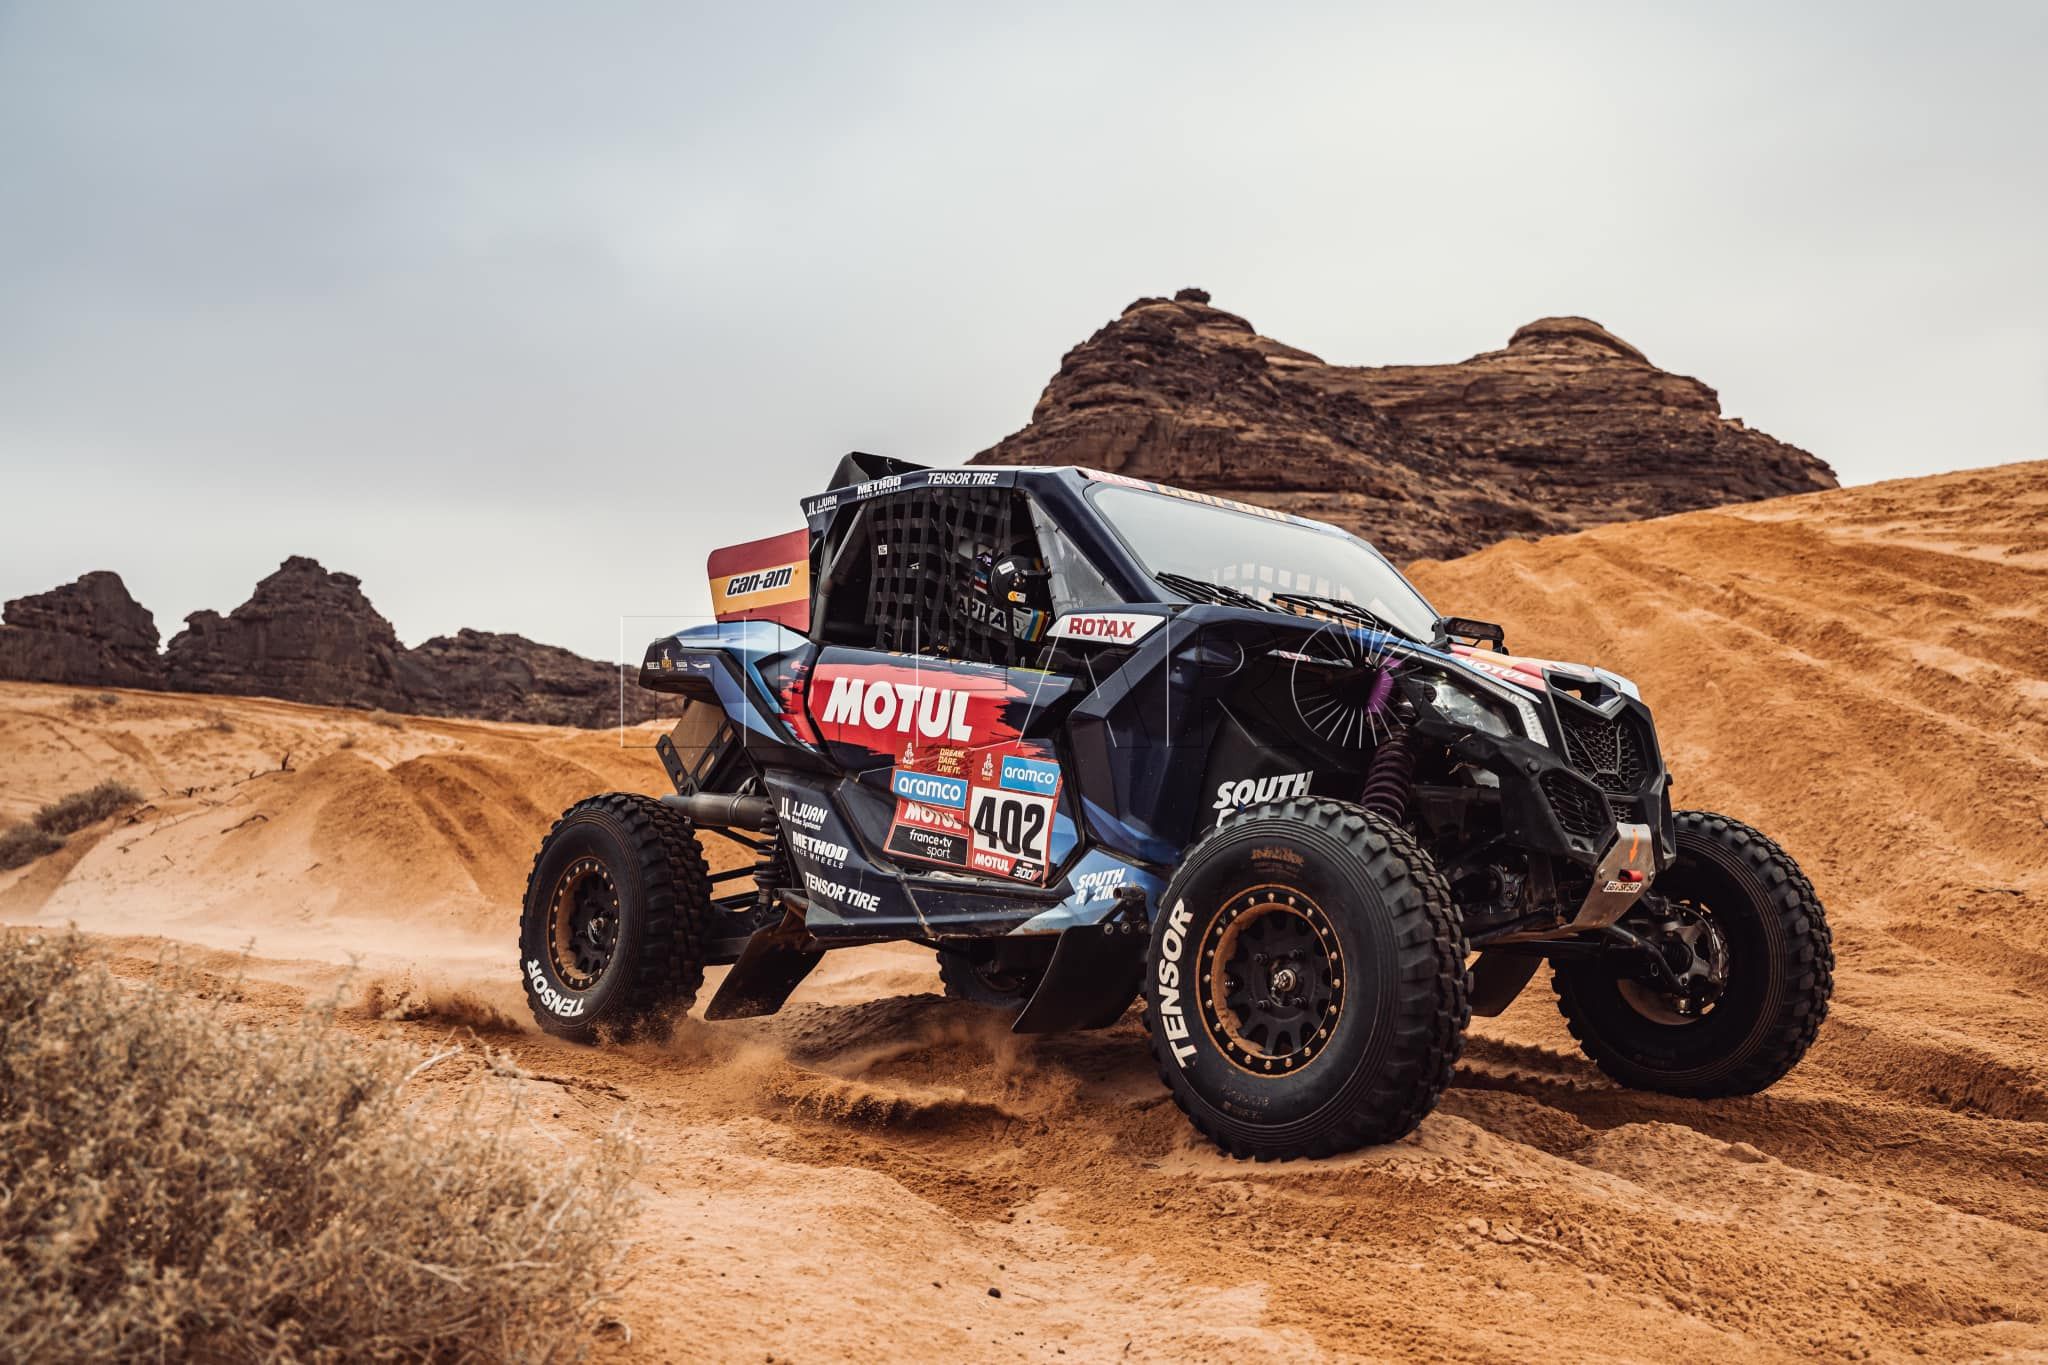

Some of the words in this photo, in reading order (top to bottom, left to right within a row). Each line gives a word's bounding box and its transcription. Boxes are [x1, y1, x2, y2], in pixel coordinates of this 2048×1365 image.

[857, 476, 901, 494] METHOD
[927, 472, 970, 485] TENSOR
[971, 472, 999, 485] TIRE
[726, 567, 793, 597] can-am
[1068, 616, 1136, 639] ROTAX
[822, 676, 973, 742] MOTUL
[898, 776, 961, 801] aramco
[1004, 766, 1055, 785] aramco
[1212, 770, 1314, 809] SOUTH
[904, 802, 962, 830] MOTUL
[974, 795, 1045, 861] 402
[792, 831, 848, 862] METHOD
[926, 844, 951, 859] sport
[810, 853, 844, 869] WHEELS
[974, 852, 1009, 872] MOTUL
[1077, 868, 1126, 890] SOUTH
[805, 872, 846, 902] TENSOR
[846, 889, 881, 913] TIRE
[527, 958, 585, 1017] TENSOR
[1158, 897, 1198, 1069] TENSOR
